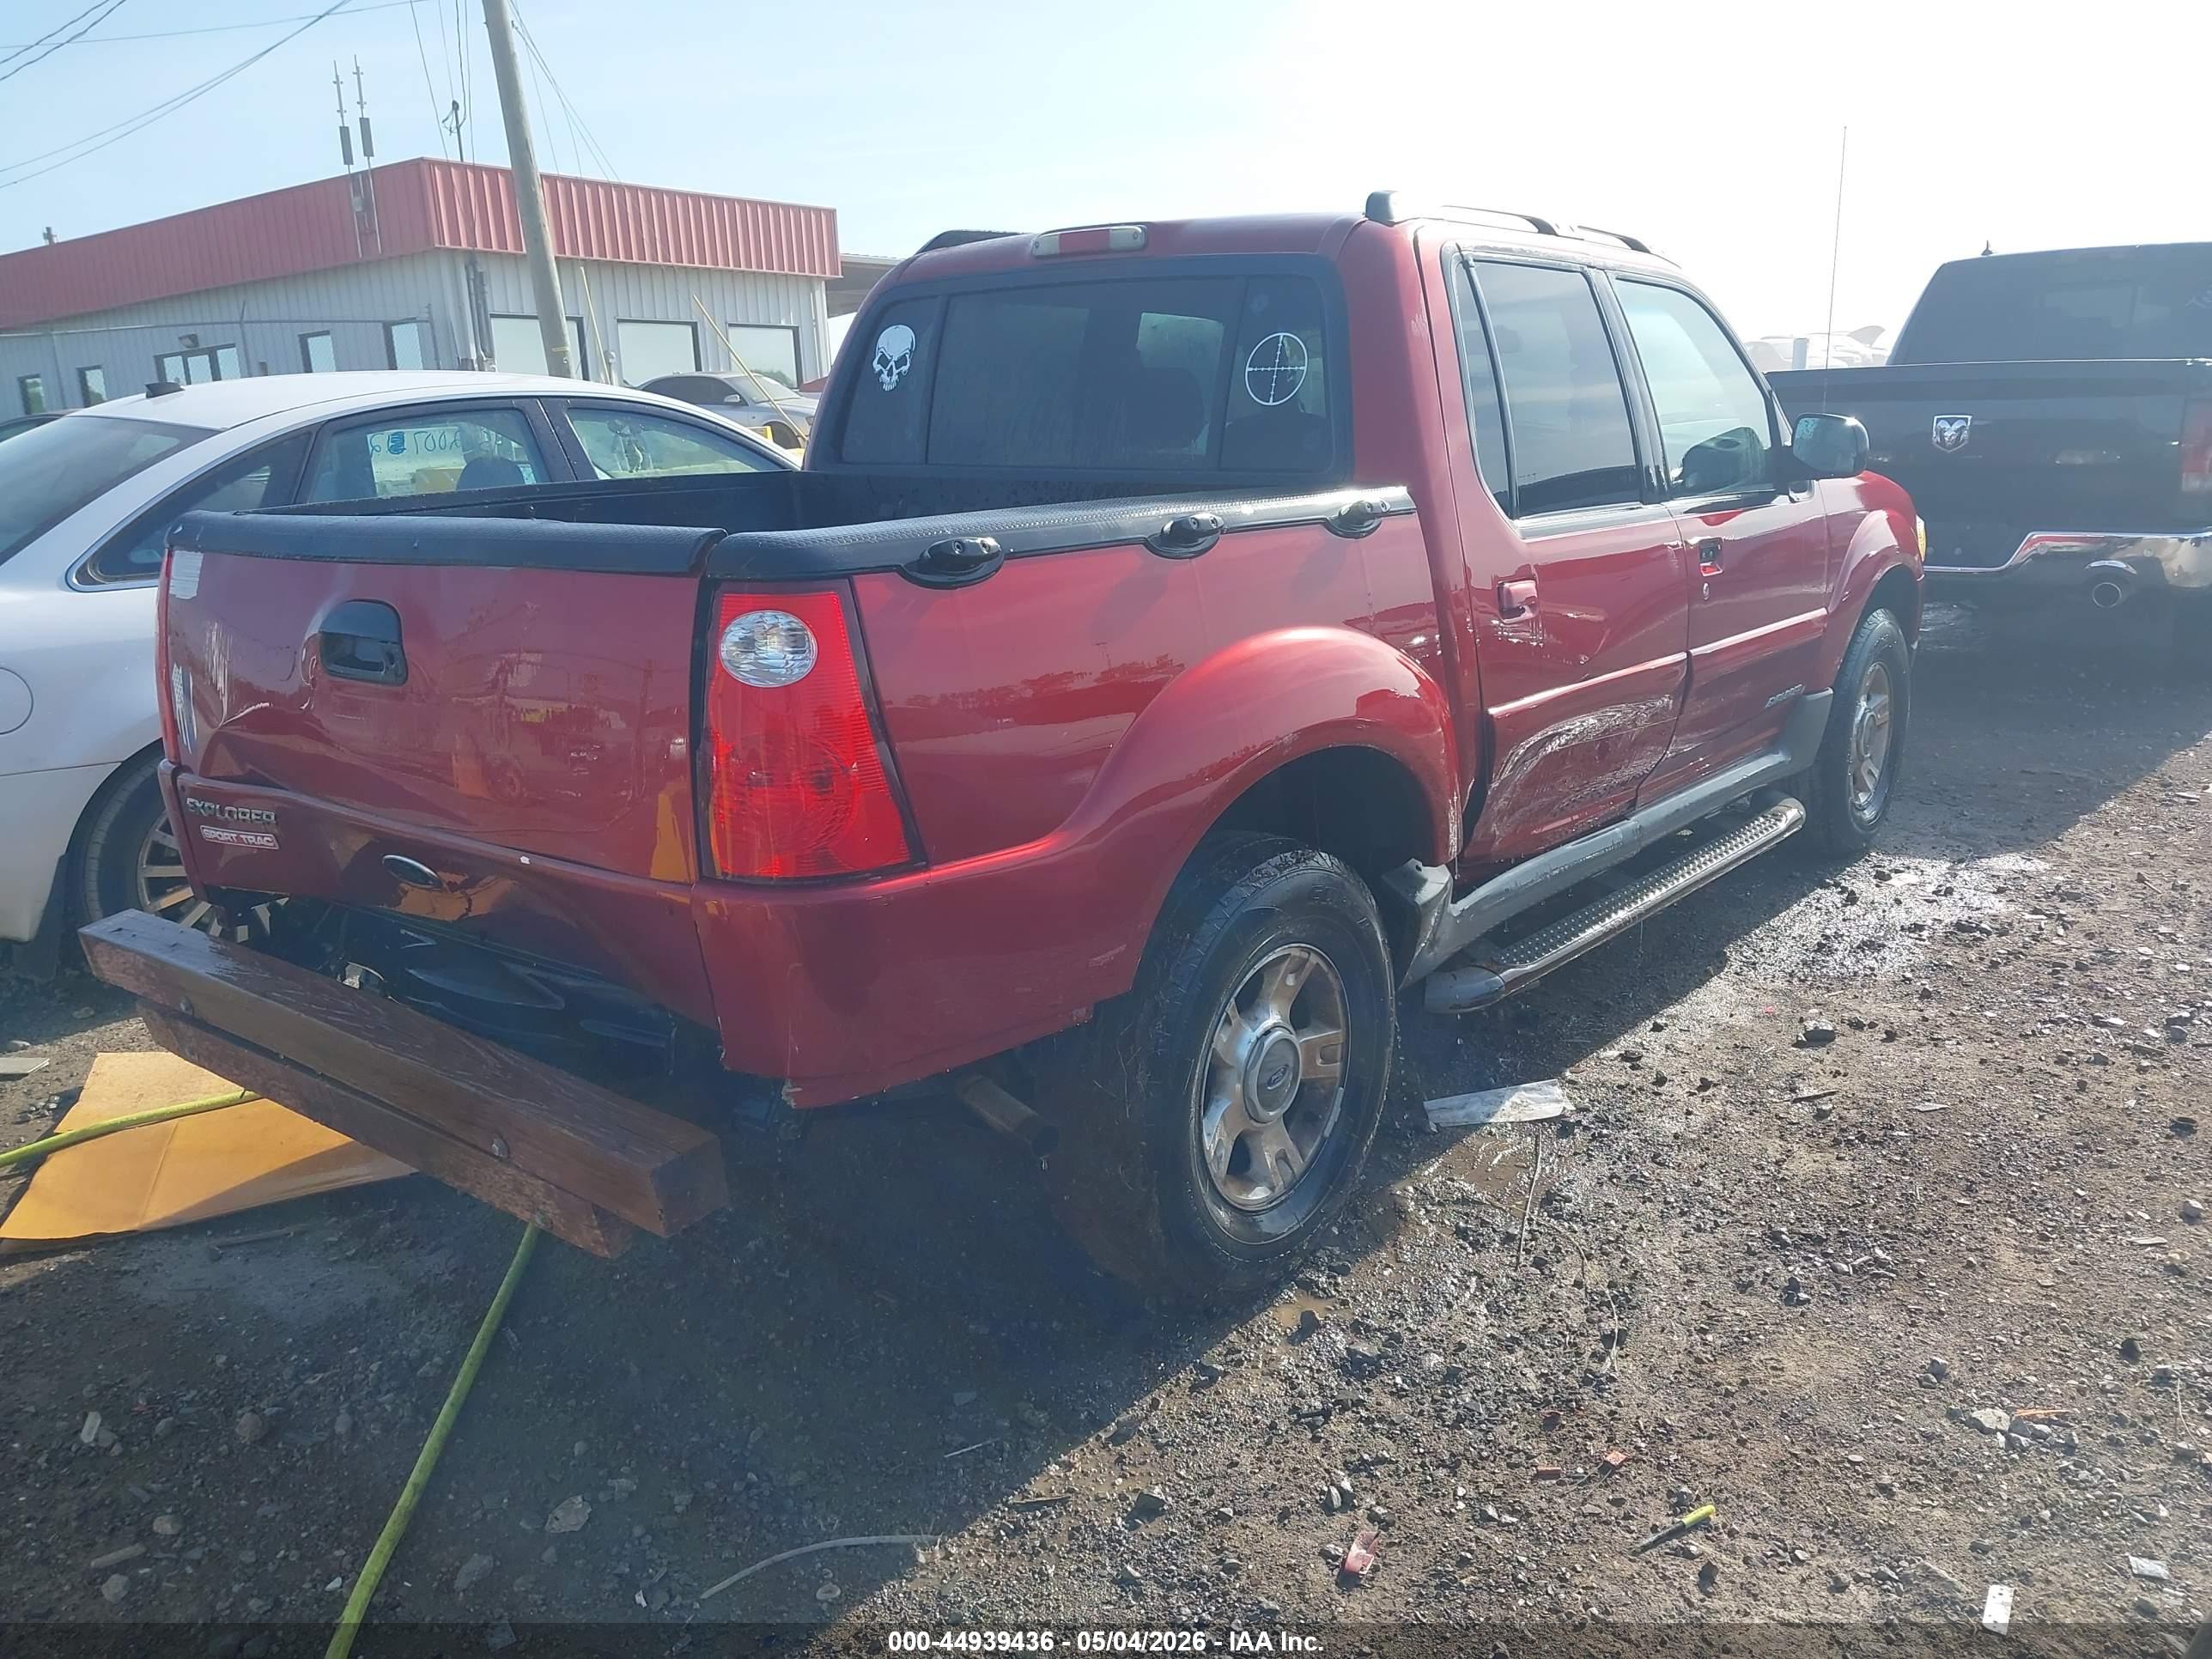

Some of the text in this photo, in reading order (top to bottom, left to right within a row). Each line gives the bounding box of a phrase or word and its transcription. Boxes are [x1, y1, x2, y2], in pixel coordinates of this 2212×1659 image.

[185, 797, 278, 825] EXPLORER
[203, 828, 275, 847] SPORT TRAC
